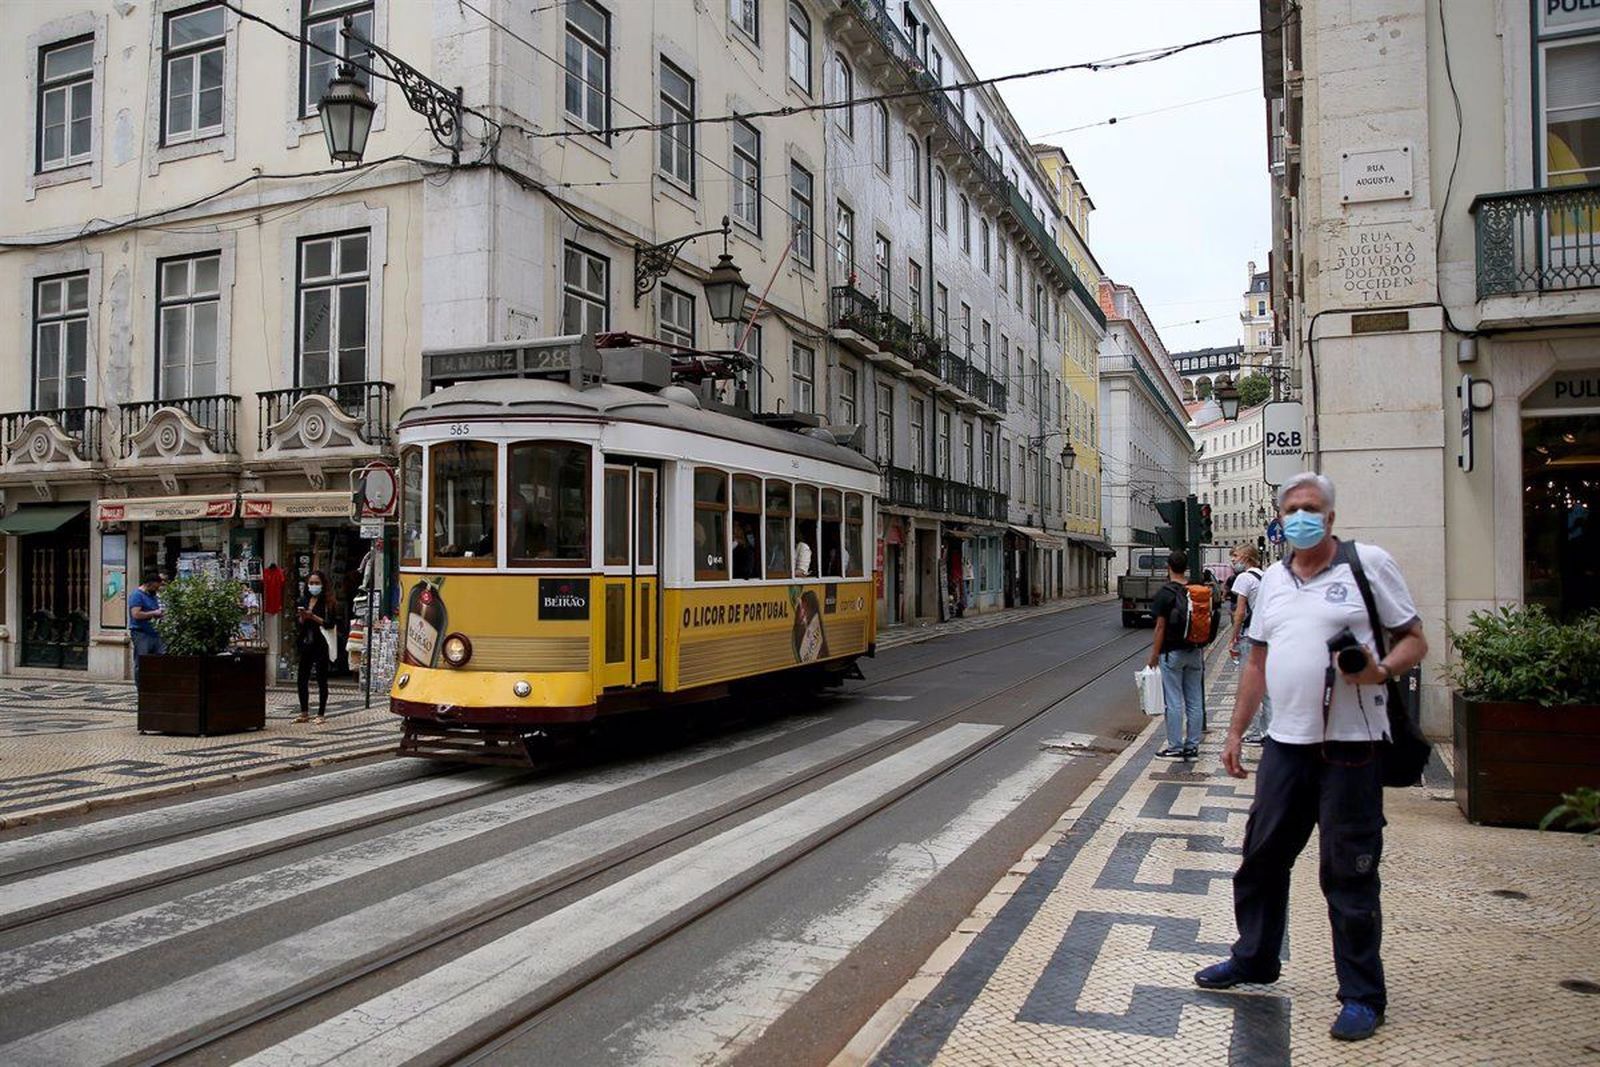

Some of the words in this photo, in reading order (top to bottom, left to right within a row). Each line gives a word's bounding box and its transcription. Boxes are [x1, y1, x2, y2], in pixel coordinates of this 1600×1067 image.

[1355, 176, 1395, 186] AUGUSTA
[1360, 232, 1392, 243] RUA
[1338, 242, 1414, 257] AUGUSTA
[1361, 290, 1393, 301] TAL
[538, 350, 569, 369] 28
[450, 424, 470, 436] 565
[1266, 431, 1302, 448] P&B
[683, 608, 691, 628] O
[694, 605, 725, 627] LICOR
[727, 604, 741, 623] DE
[743, 601, 788, 622] PORTUGAL
